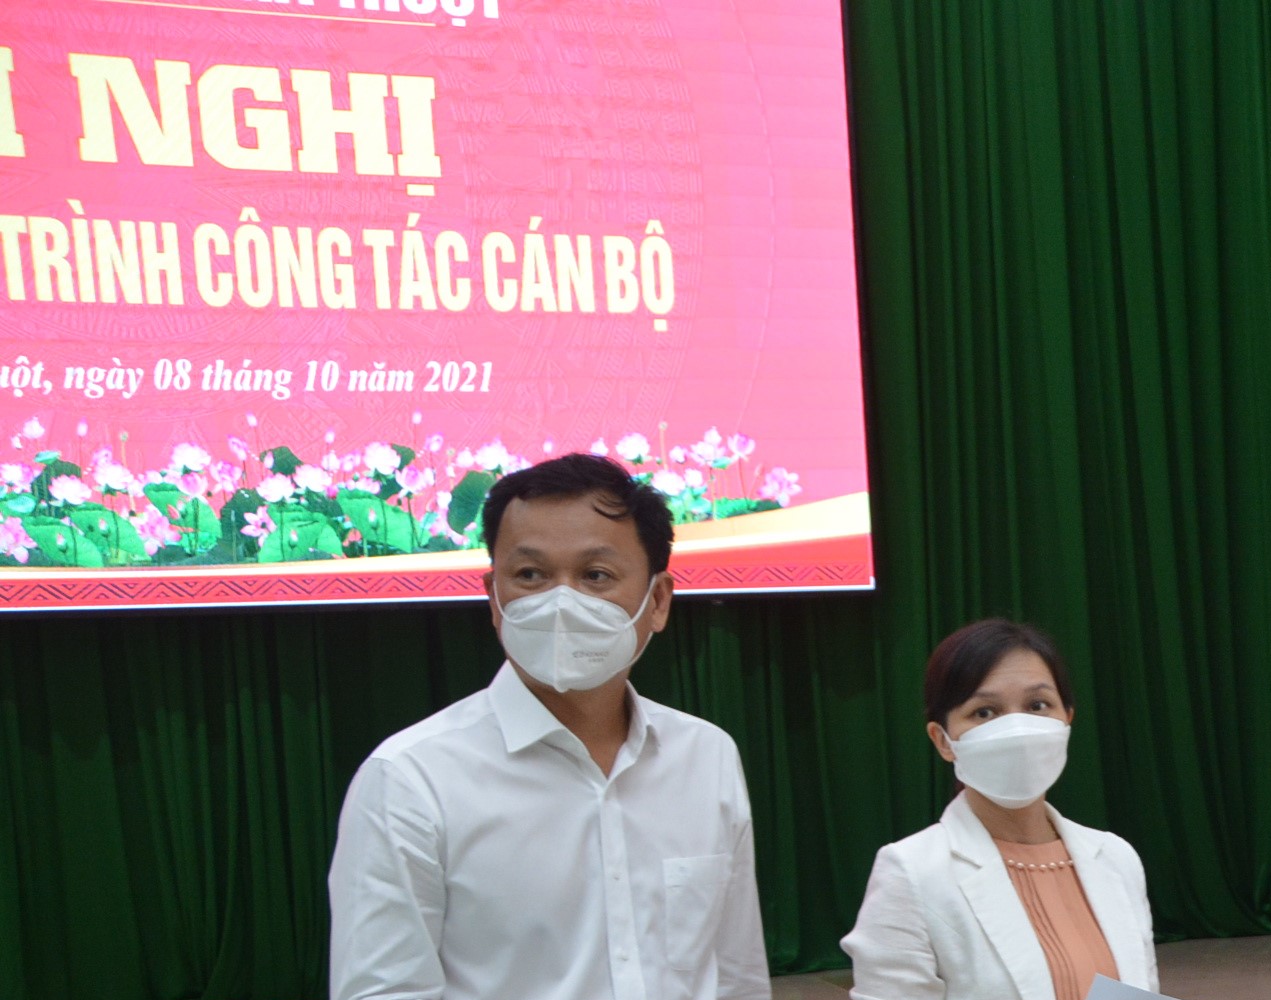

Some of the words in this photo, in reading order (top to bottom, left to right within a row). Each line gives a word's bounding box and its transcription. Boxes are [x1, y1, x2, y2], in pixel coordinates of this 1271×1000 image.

[69, 53, 442, 196] NGHỊ
[0, 199, 184, 305] TRÌNH
[193, 207, 356, 309] CÔNG
[363, 212, 471, 311] TÁC
[482, 216, 592, 313] CÁN
[603, 219, 675, 332] BỘ
[64, 357, 144, 399] ngày
[154, 358, 192, 390] 08
[202, 359, 293, 400] tháng
[305, 360, 340, 391] 10
[348, 362, 415, 392] năm
[424, 361, 493, 392] 2021
